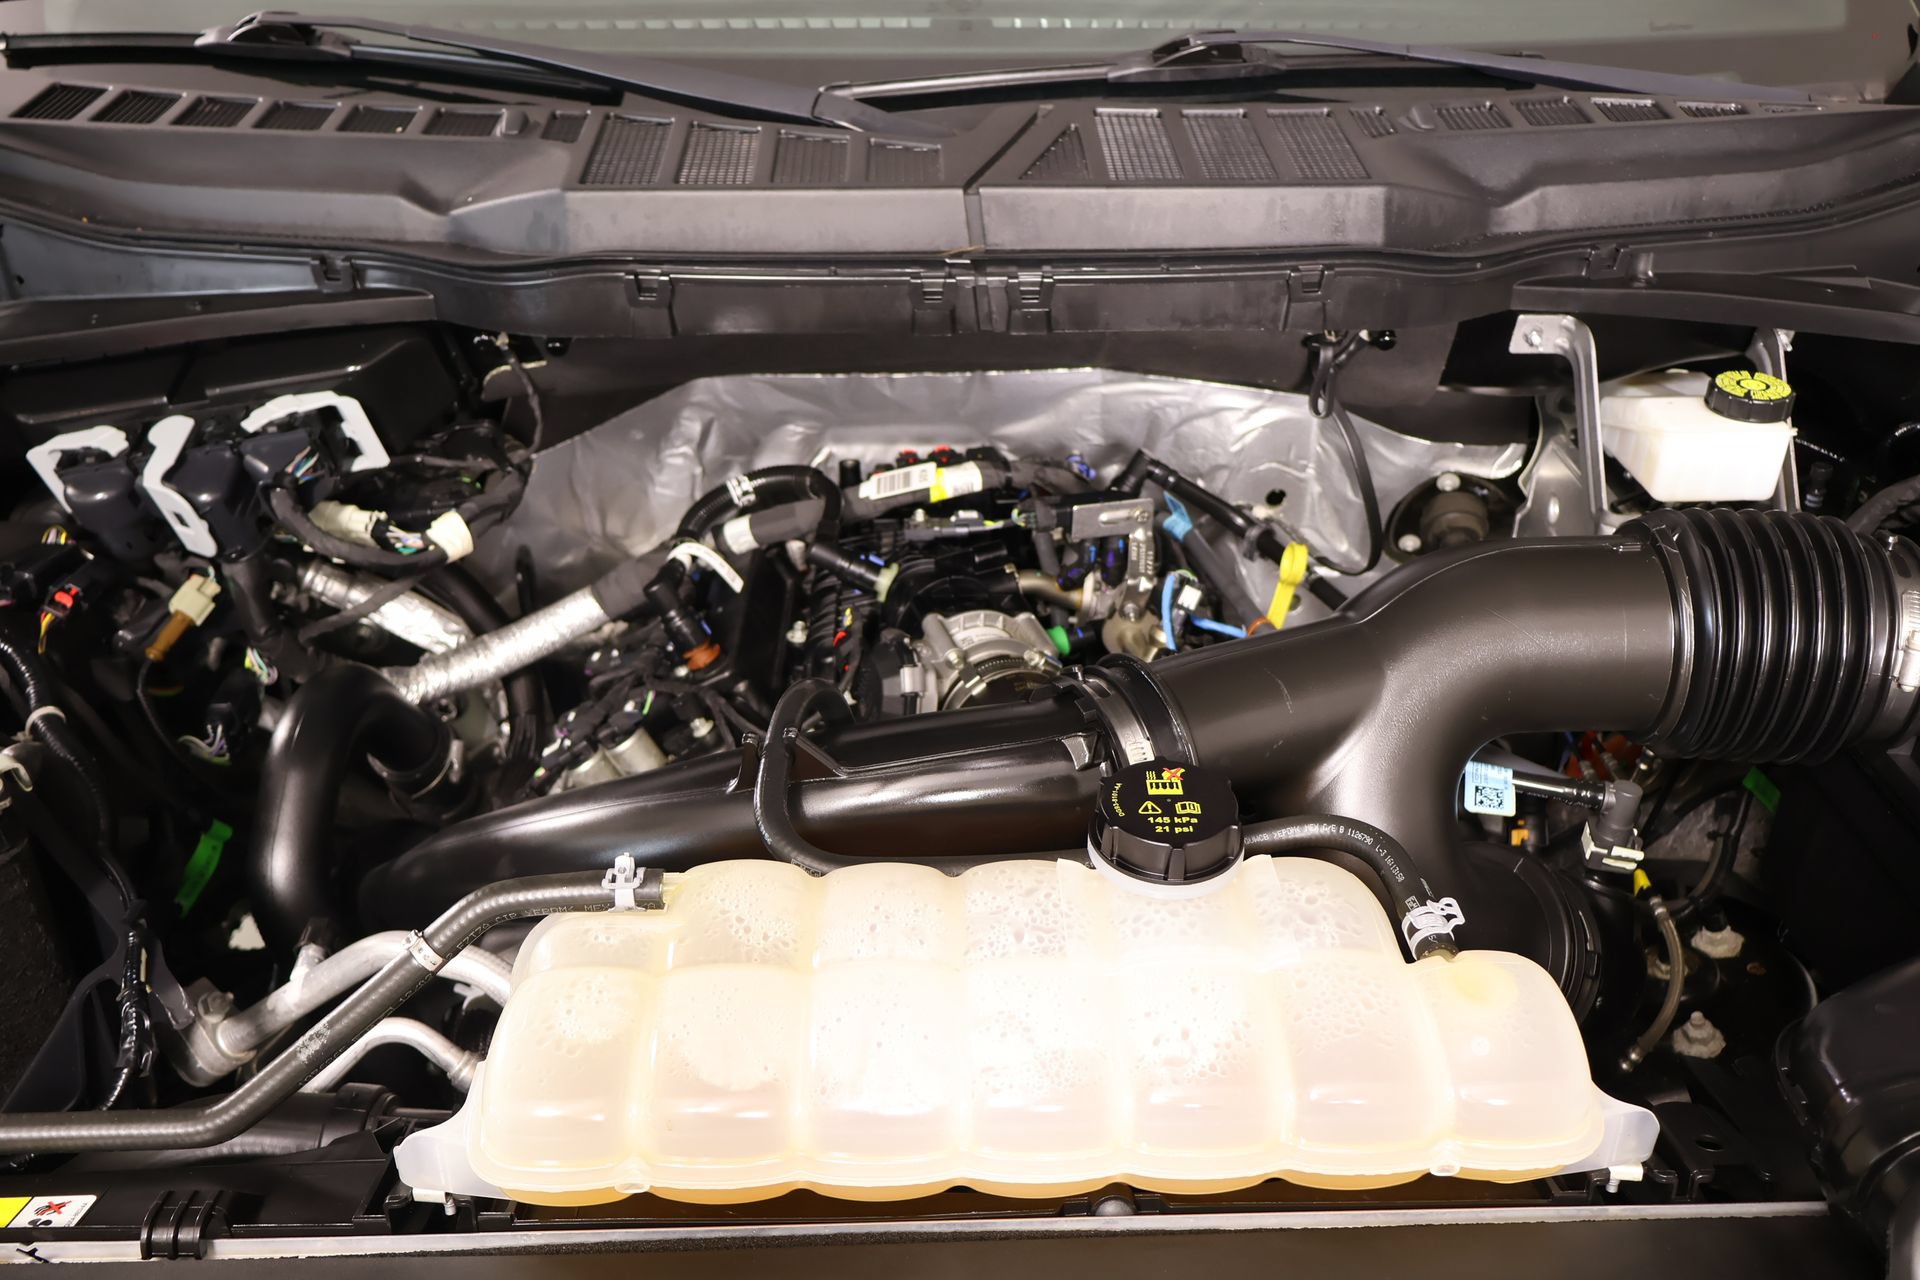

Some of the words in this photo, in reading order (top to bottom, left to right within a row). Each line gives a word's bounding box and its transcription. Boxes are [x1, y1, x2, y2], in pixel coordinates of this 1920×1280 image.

[1173, 816, 1198, 824] kPa
[1154, 825, 1170, 833] 21
[1174, 826, 1194, 834] psi
[1375, 844, 1387, 857] L-3
